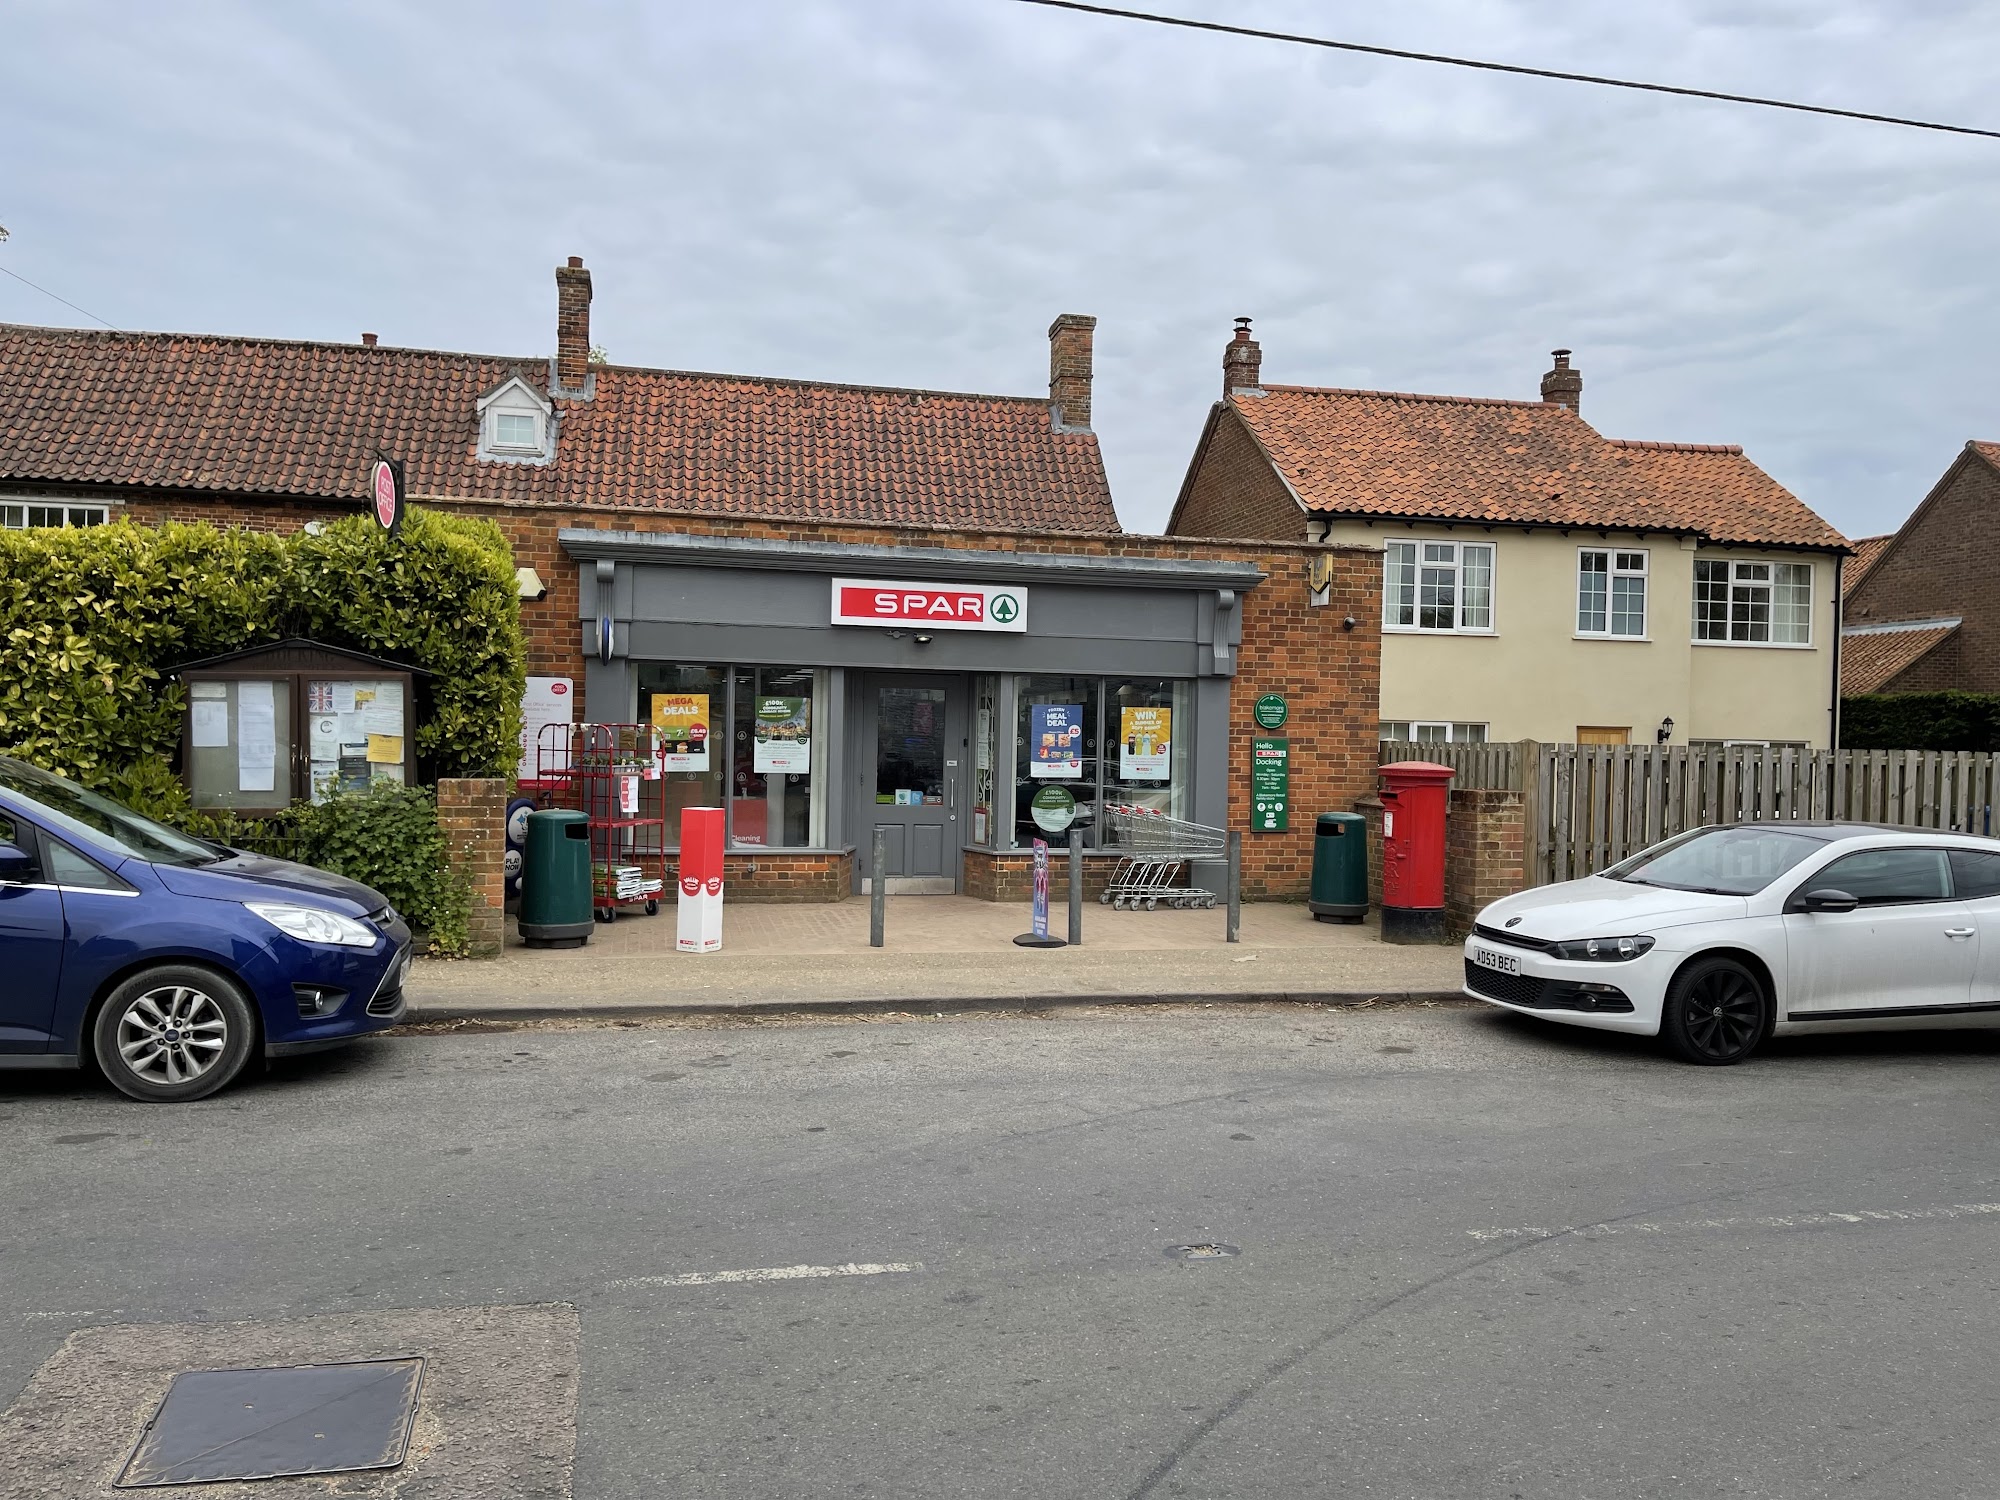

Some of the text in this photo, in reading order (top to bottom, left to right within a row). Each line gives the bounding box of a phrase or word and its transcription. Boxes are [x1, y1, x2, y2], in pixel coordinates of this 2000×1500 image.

[380, 476, 392, 494] POST
[378, 490, 392, 513] OFFICE
[874, 593, 982, 617] SPAR
[667, 697, 694, 706] MEGA
[663, 706, 699, 715] DEALS
[1134, 711, 1157, 720] WIN
[1256, 758, 1282, 767] Docking
[629, 894, 648, 902] SPAR
[1476, 950, 1516, 972] AD53 BEC
